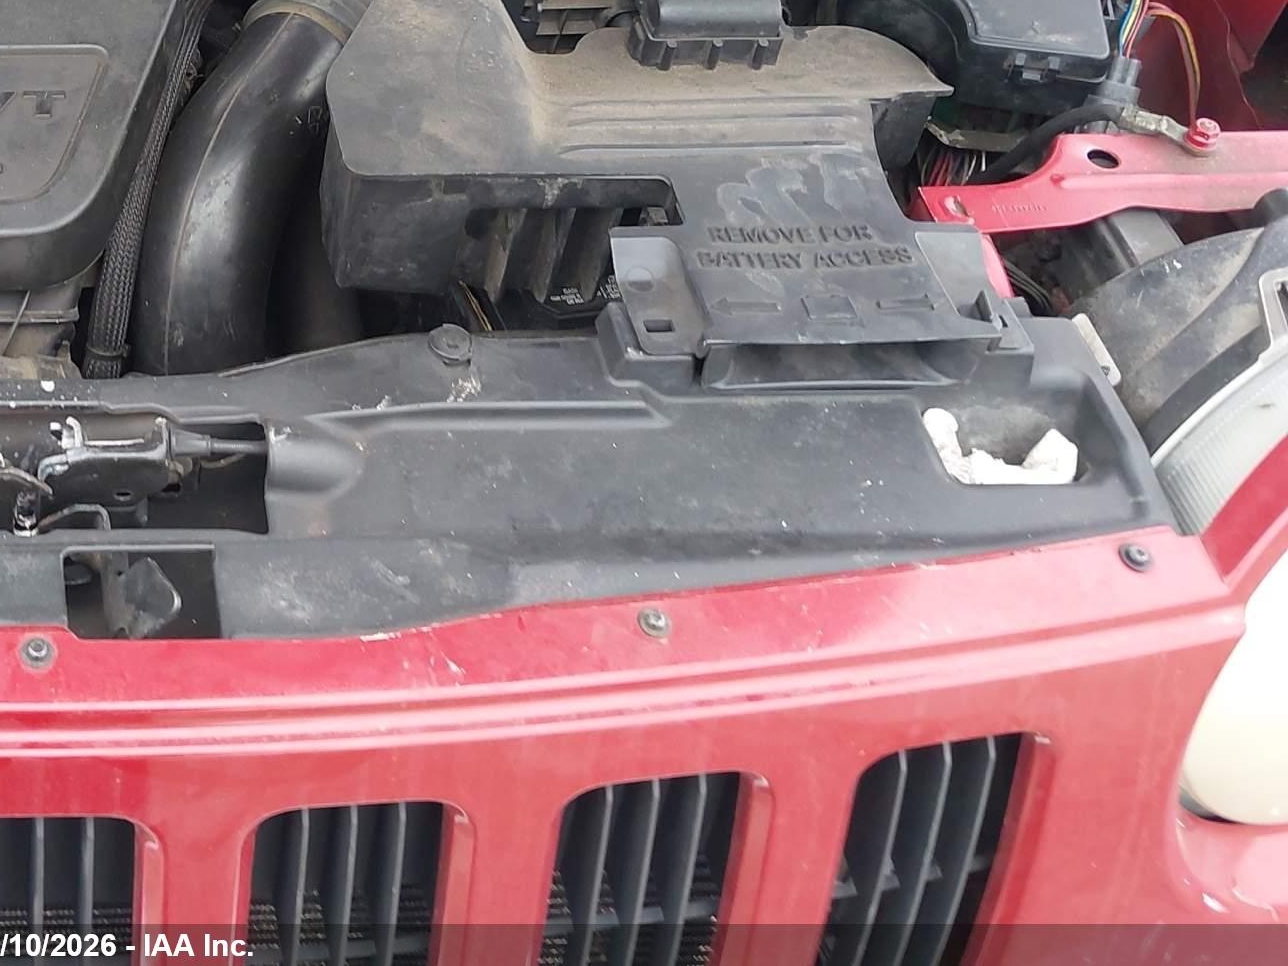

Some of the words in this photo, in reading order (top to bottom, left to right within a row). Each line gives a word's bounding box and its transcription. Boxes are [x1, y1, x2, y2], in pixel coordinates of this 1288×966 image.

[709, 226, 814, 244] REMOVE
[819, 225, 874, 243] FOR
[696, 249, 802, 270] BATTERY
[813, 247, 913, 268] ACCESS
